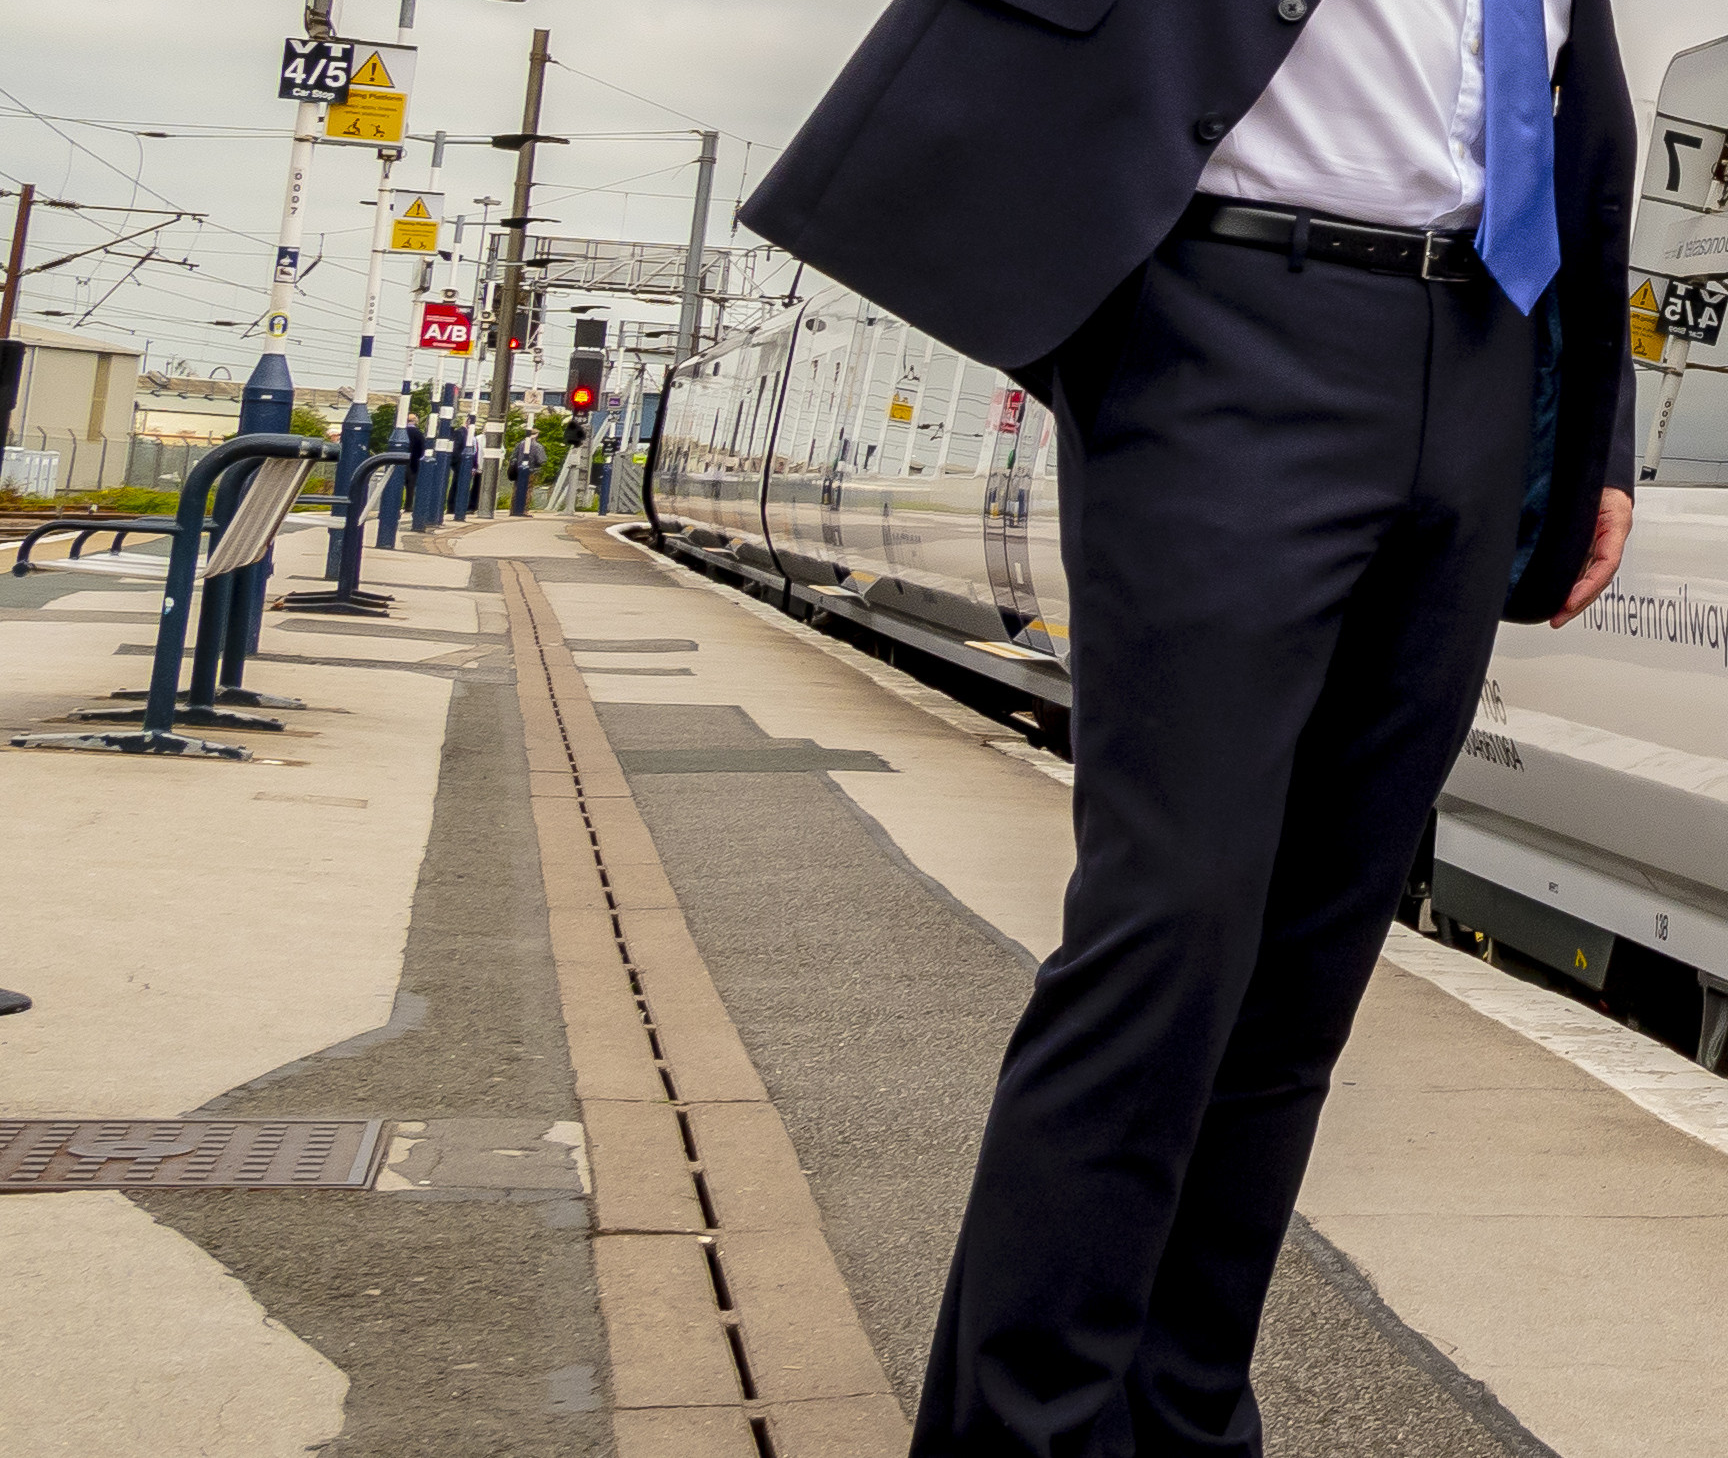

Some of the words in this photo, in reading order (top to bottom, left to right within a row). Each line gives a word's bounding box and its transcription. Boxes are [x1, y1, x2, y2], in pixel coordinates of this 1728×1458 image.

[284, 57, 348, 88] 4/5
[292, 88, 311, 97] Car
[312, 89, 336, 100] Stop
[423, 323, 468, 342] A/B
